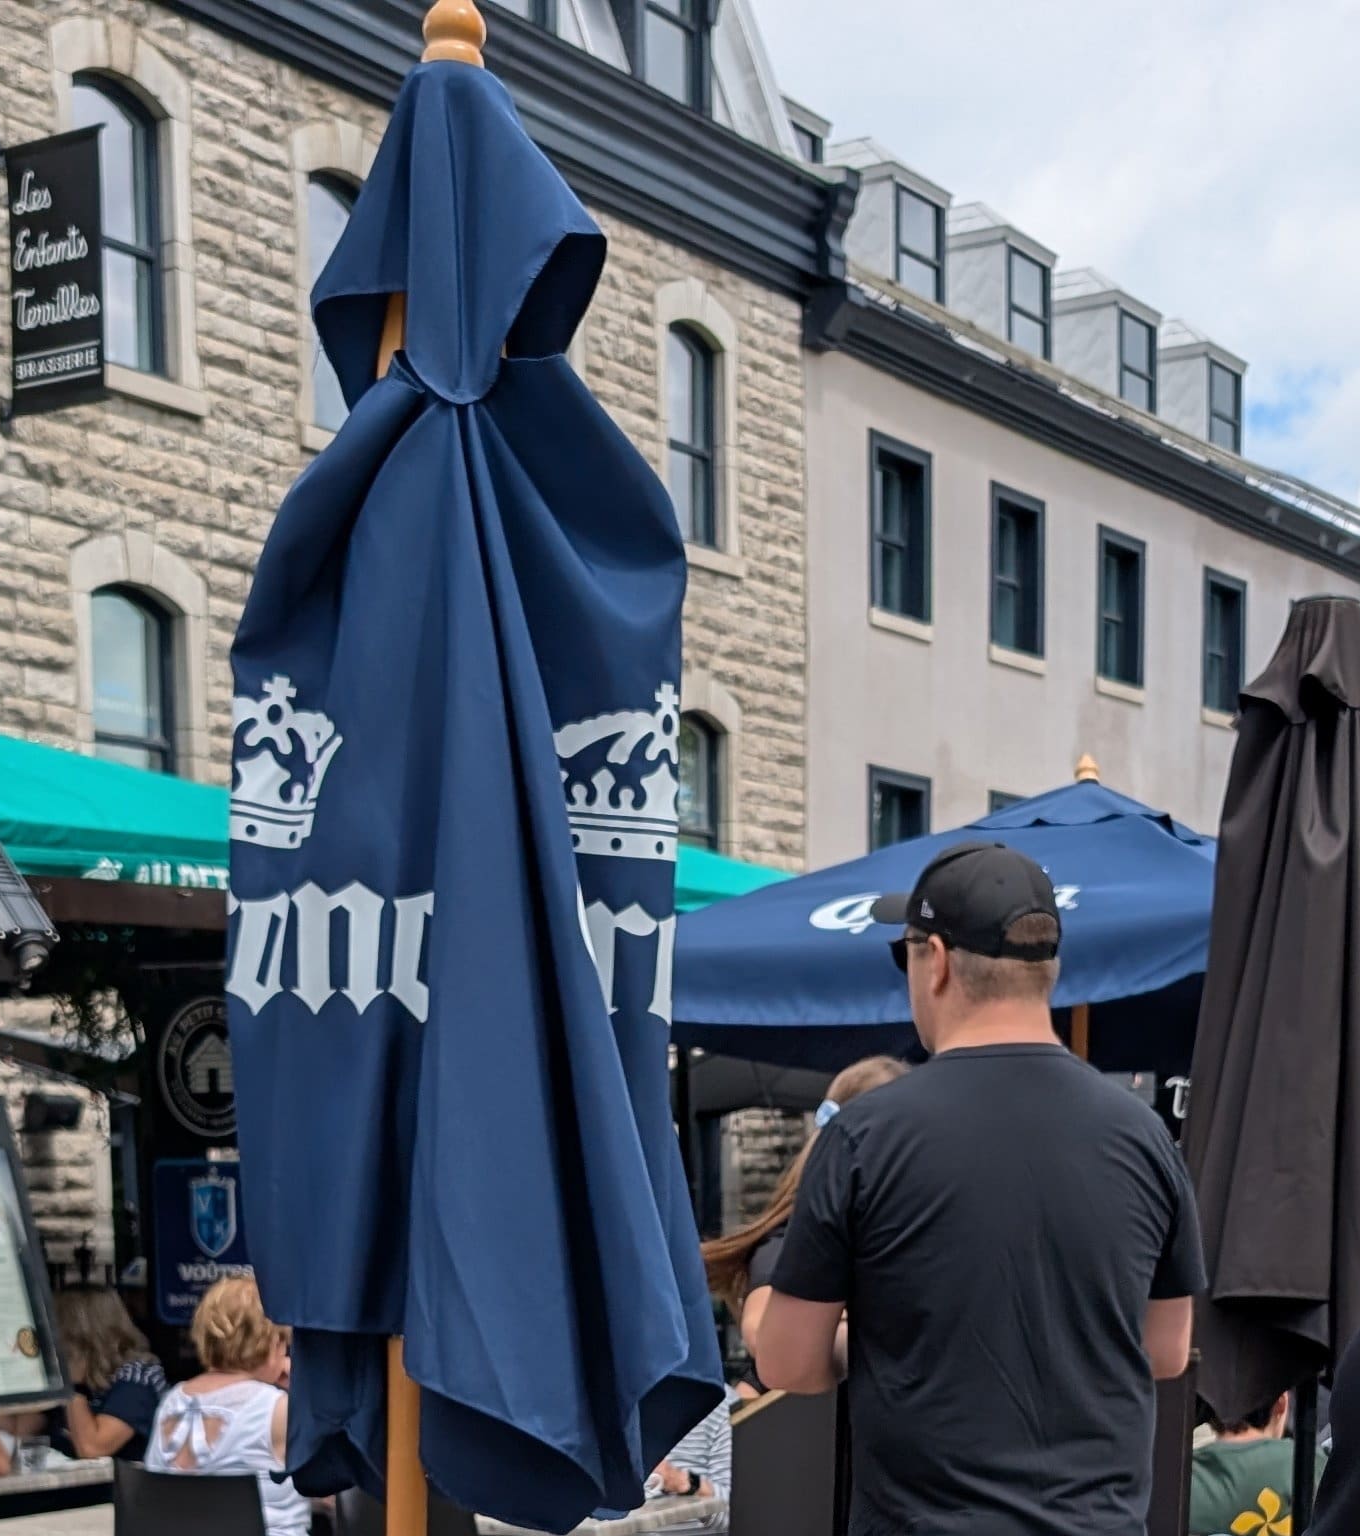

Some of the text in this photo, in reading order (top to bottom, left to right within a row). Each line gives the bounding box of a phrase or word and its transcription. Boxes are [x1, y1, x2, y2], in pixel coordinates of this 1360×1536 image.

[12, 169, 52, 215] Les
[13, 224, 88, 272] Enfants
[16, 348, 98, 381] BRASSERIE
